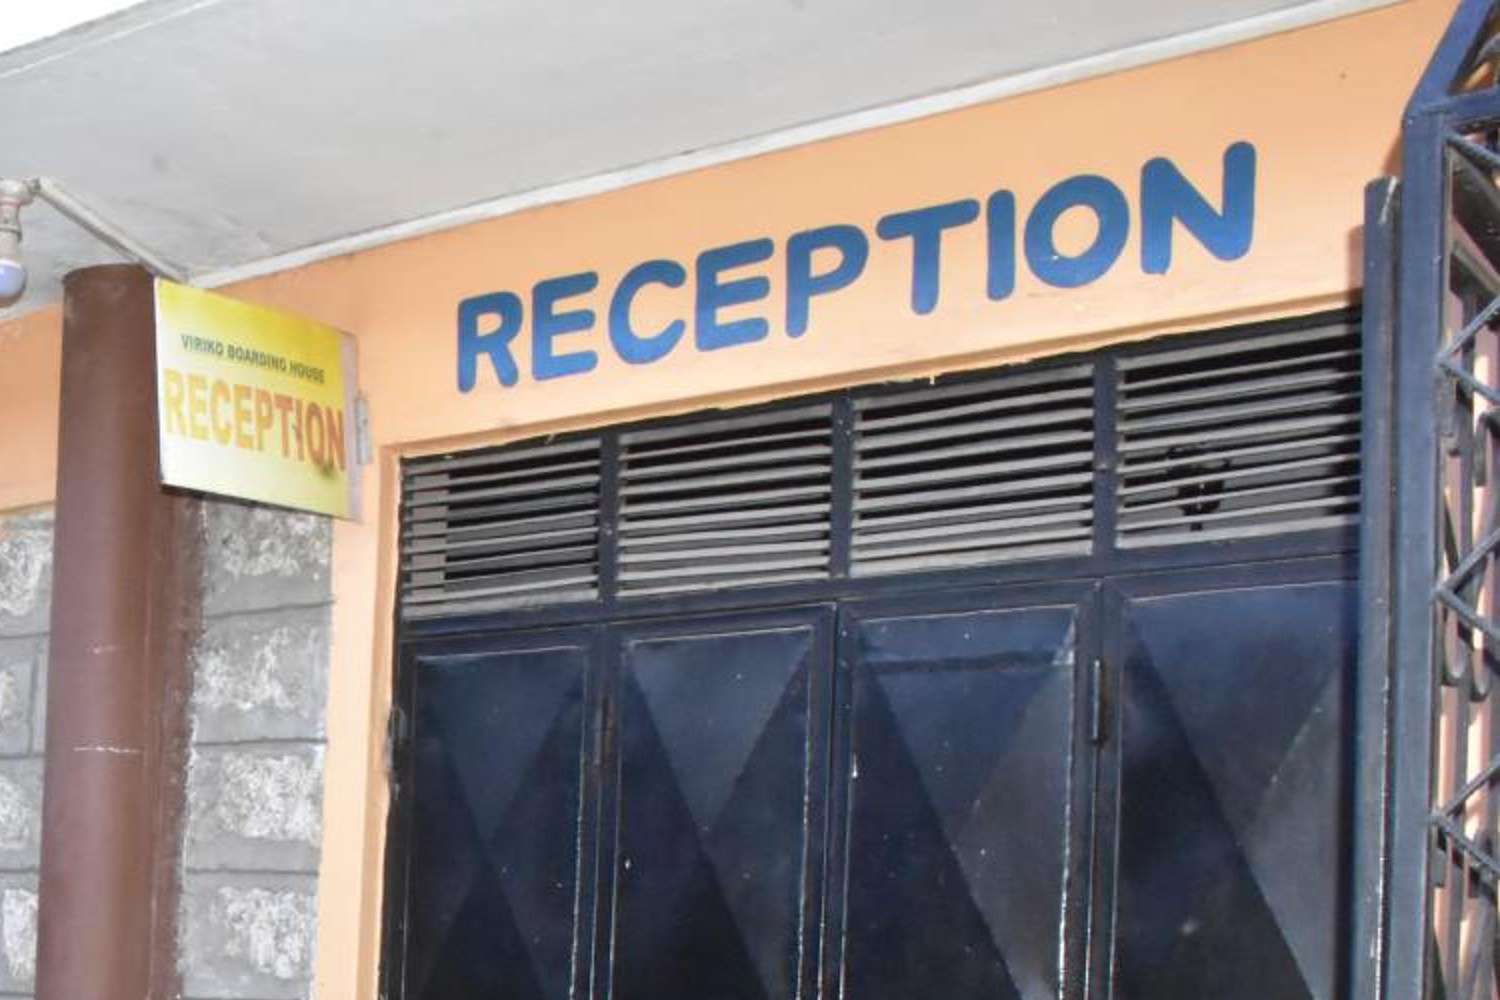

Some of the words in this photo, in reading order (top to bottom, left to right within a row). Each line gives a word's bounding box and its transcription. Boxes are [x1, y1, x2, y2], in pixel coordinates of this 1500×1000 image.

[457, 140, 1258, 394] RECEPTION
[227, 343, 288, 373] BOARDING
[289, 360, 326, 385] HOUSE
[163, 368, 346, 472] RECEPTION
